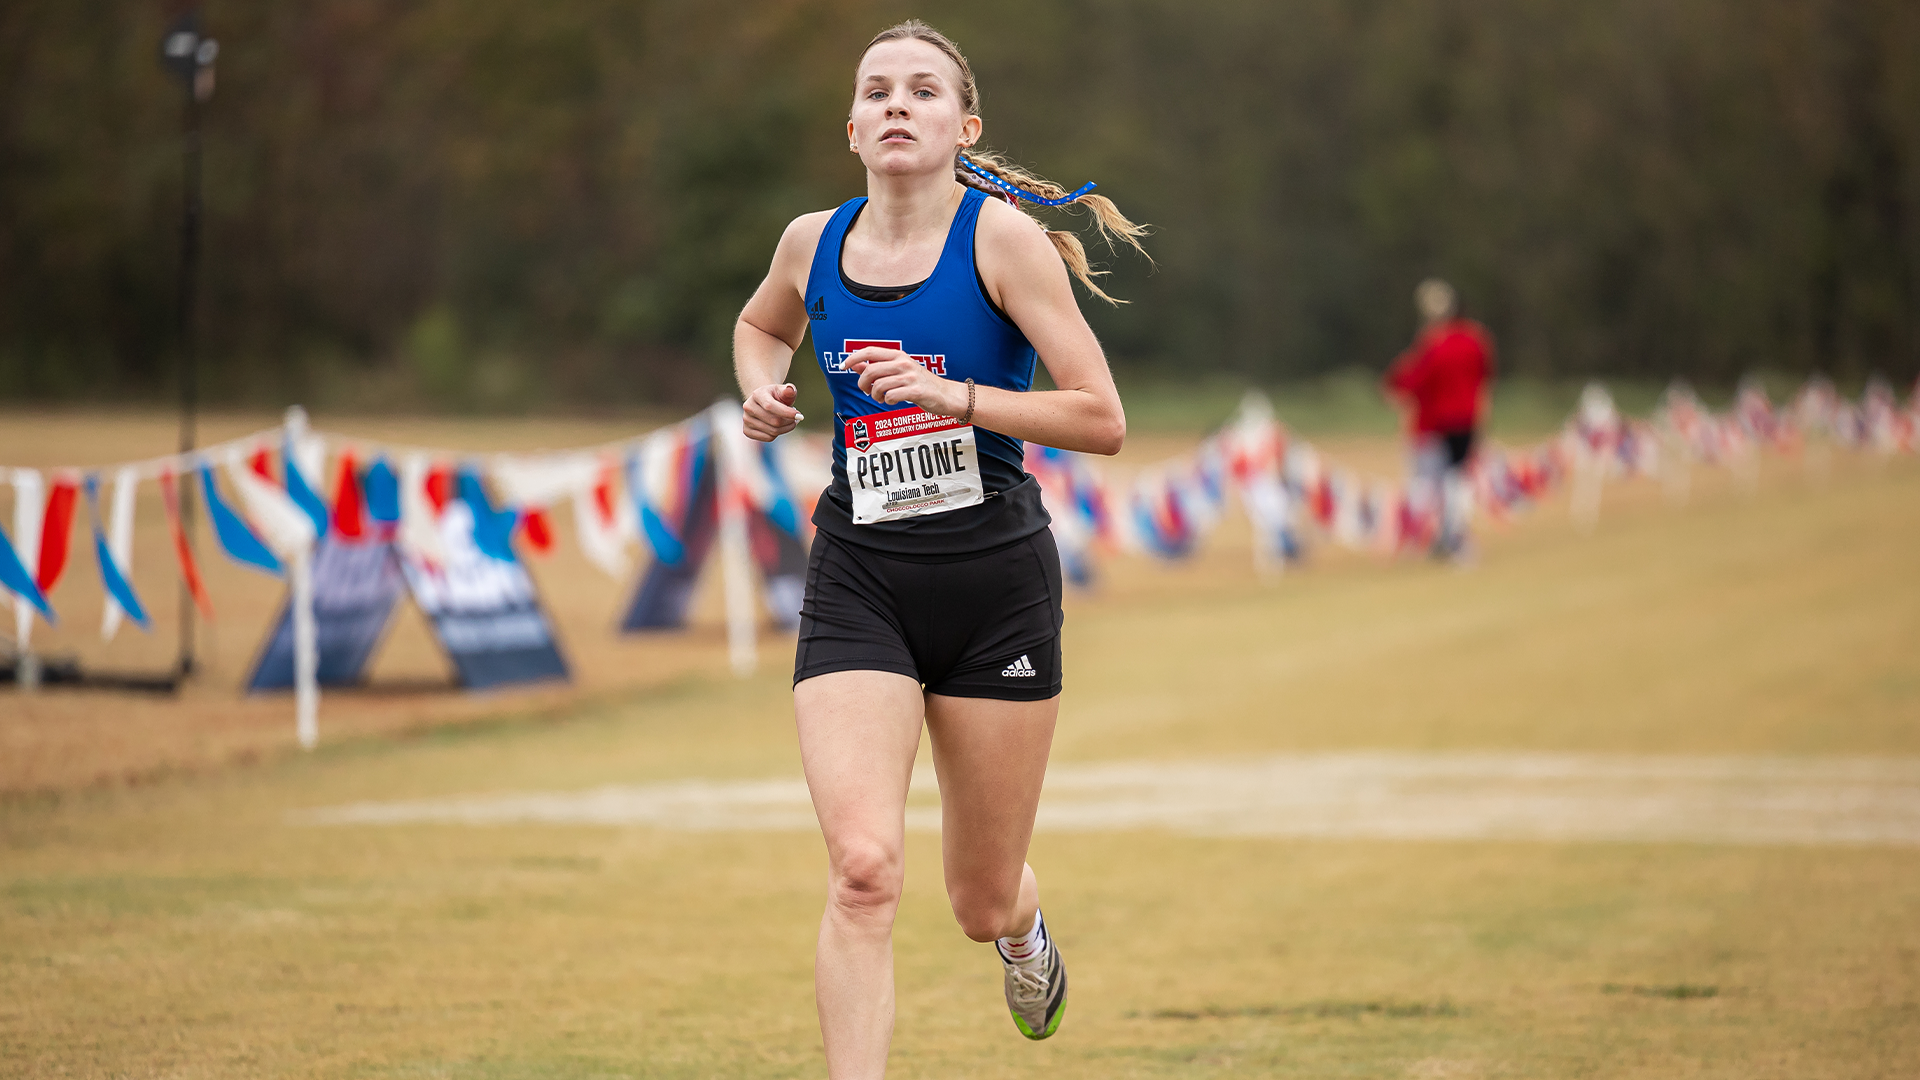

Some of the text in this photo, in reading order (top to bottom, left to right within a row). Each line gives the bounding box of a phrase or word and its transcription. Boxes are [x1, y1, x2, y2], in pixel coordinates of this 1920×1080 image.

[874, 419, 893, 430] 2024
[876, 429, 893, 438] CROSS
[893, 424, 915, 435] COUNTRY
[915, 418, 958, 431] CHAMPIONSHIPS
[857, 439, 966, 489] PEPITONE
[886, 482, 940, 502] Louisiana Tech
[886, 502, 929, 513] CHOCCOLOCCO
[1001, 668, 1036, 678] adidas
